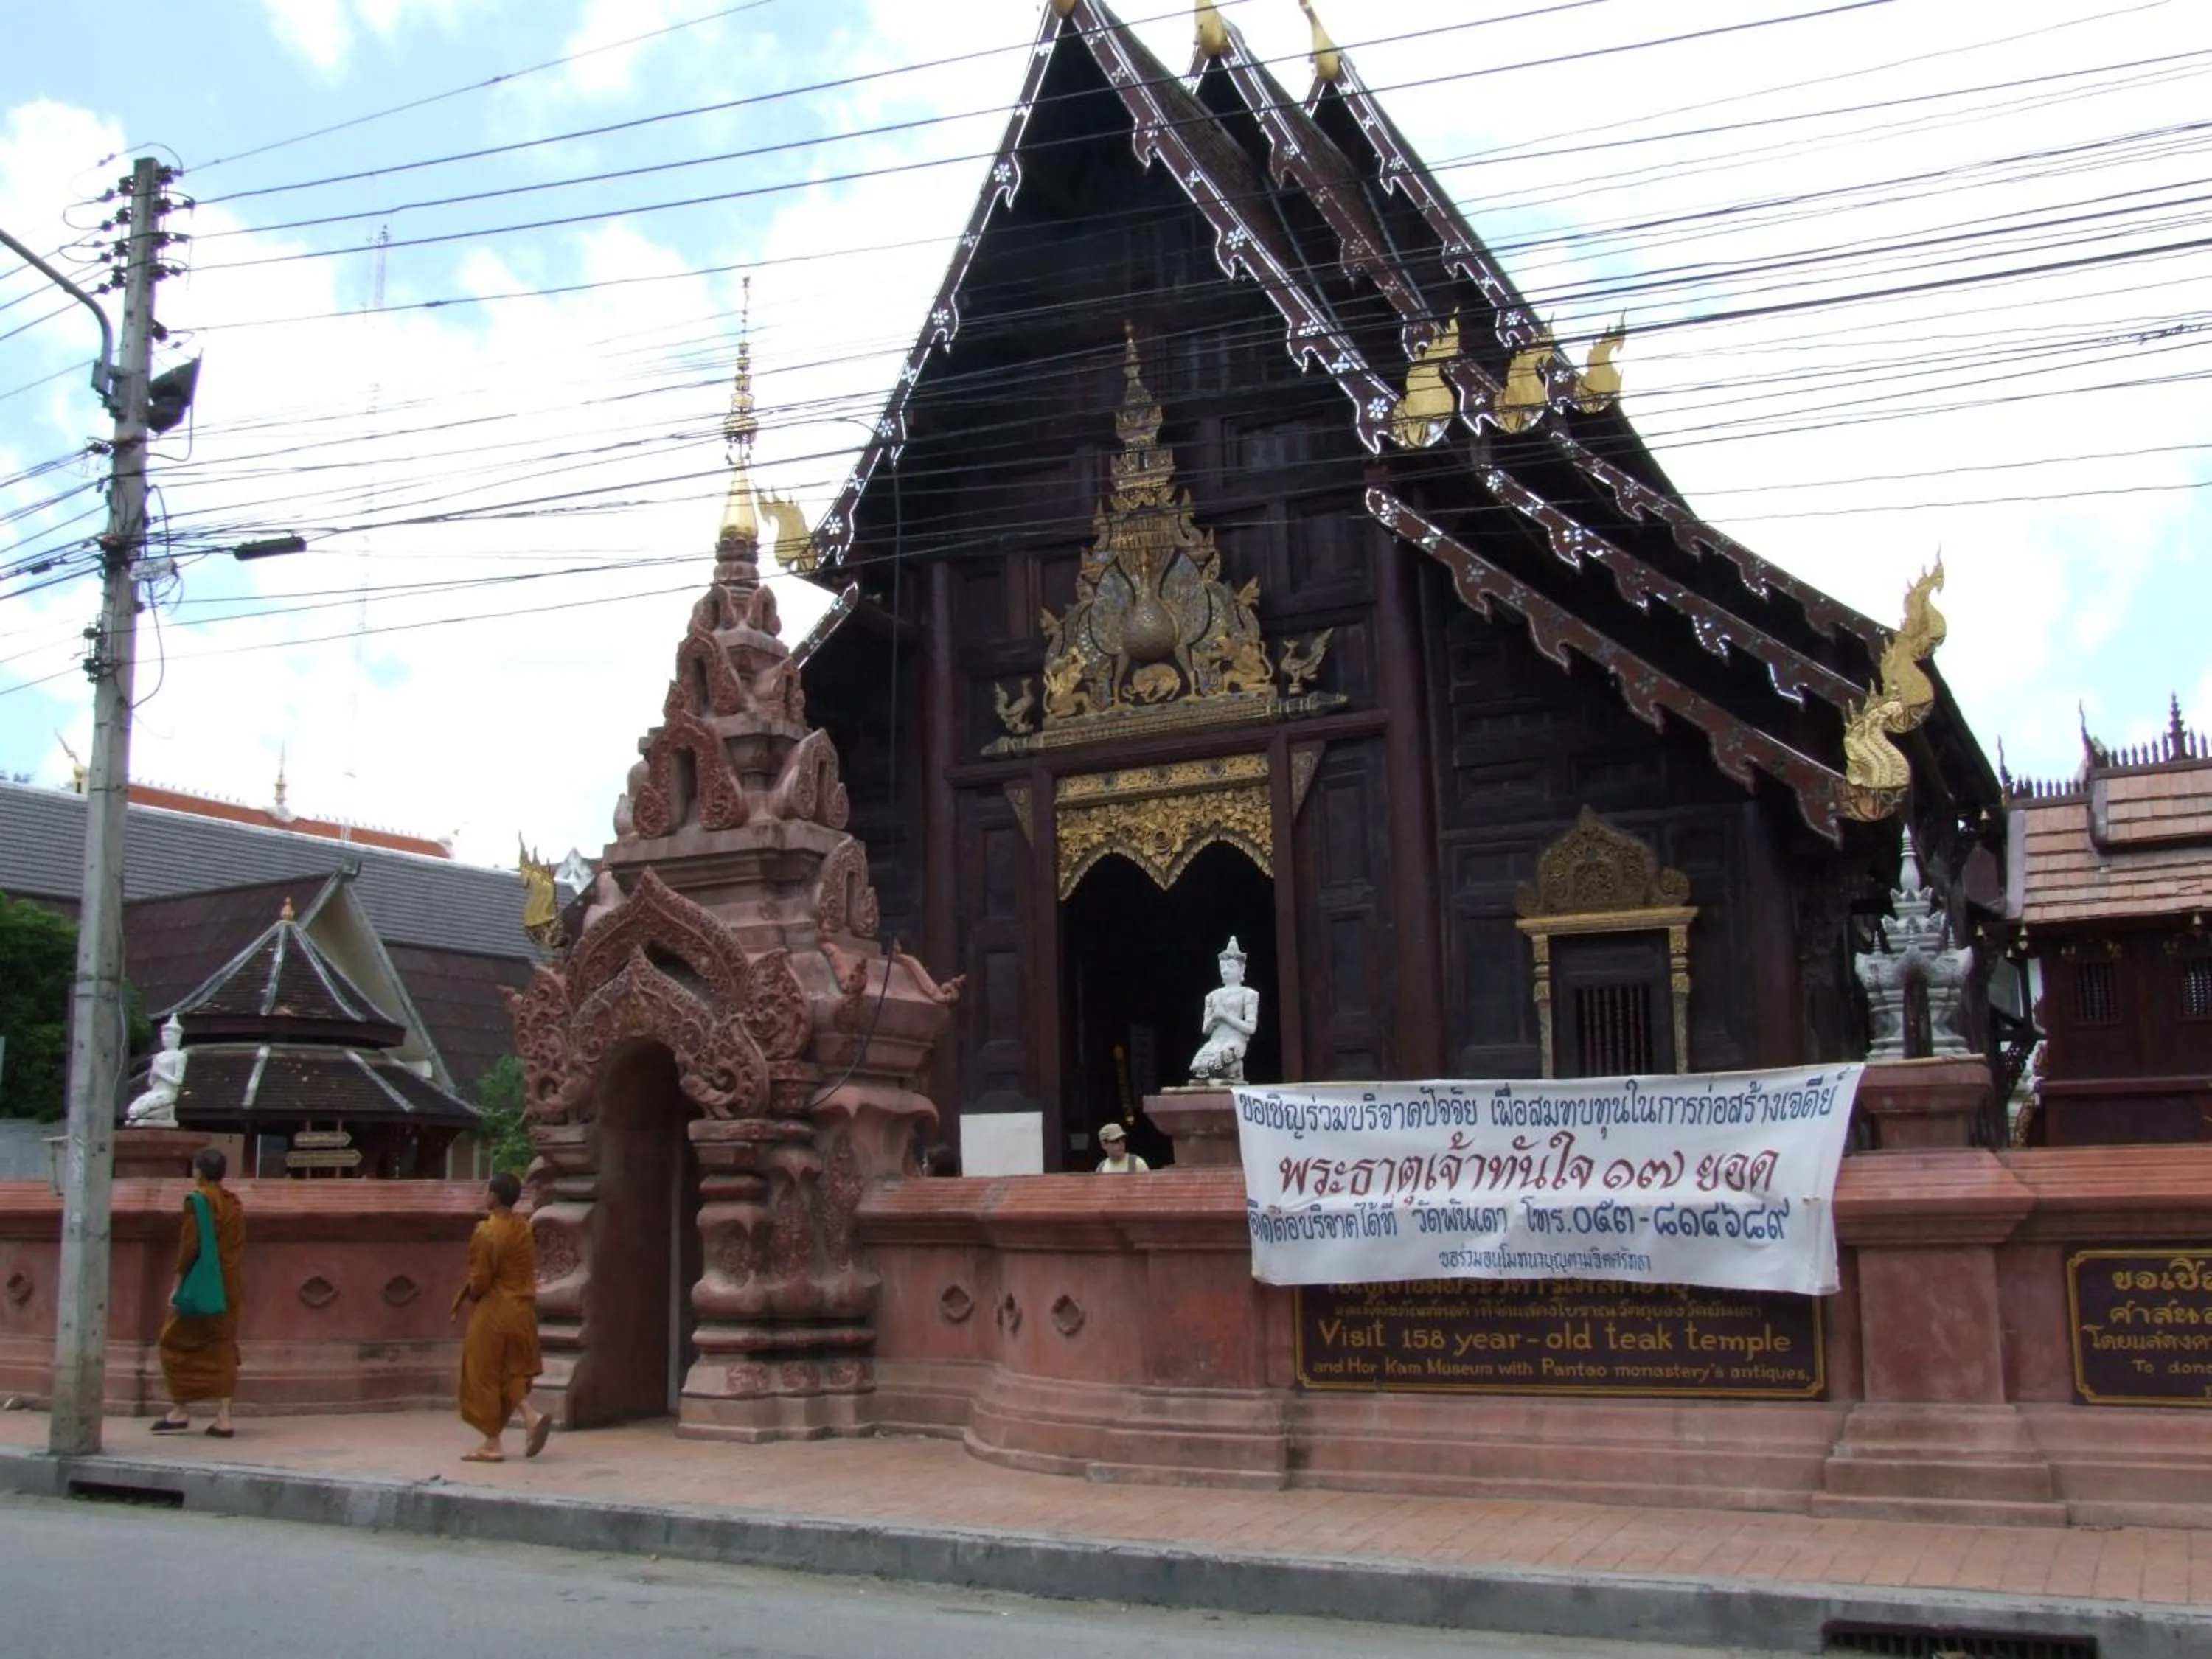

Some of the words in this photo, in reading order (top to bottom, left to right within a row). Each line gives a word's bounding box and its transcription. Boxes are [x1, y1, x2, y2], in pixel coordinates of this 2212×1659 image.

[1279, 1130, 1595, 1203] พระธาตุเจ้าทันใจ
[1695, 1150, 1779, 1192] ยอด
[1318, 1318, 1386, 1348] Visit
[1402, 1329, 1447, 1349] 158
[1604, 1321, 1673, 1350] teak
[1684, 1321, 1792, 1362] temple
[1312, 1358, 1344, 1374] and
[1348, 1357, 1378, 1374] Hor
[1385, 1357, 1422, 1375] Kam
[1427, 1357, 1494, 1377] Museum
[1498, 1360, 1534, 1377] with
[1542, 1357, 1607, 1378] Pantao
[2132, 1359, 2155, 1373] To
